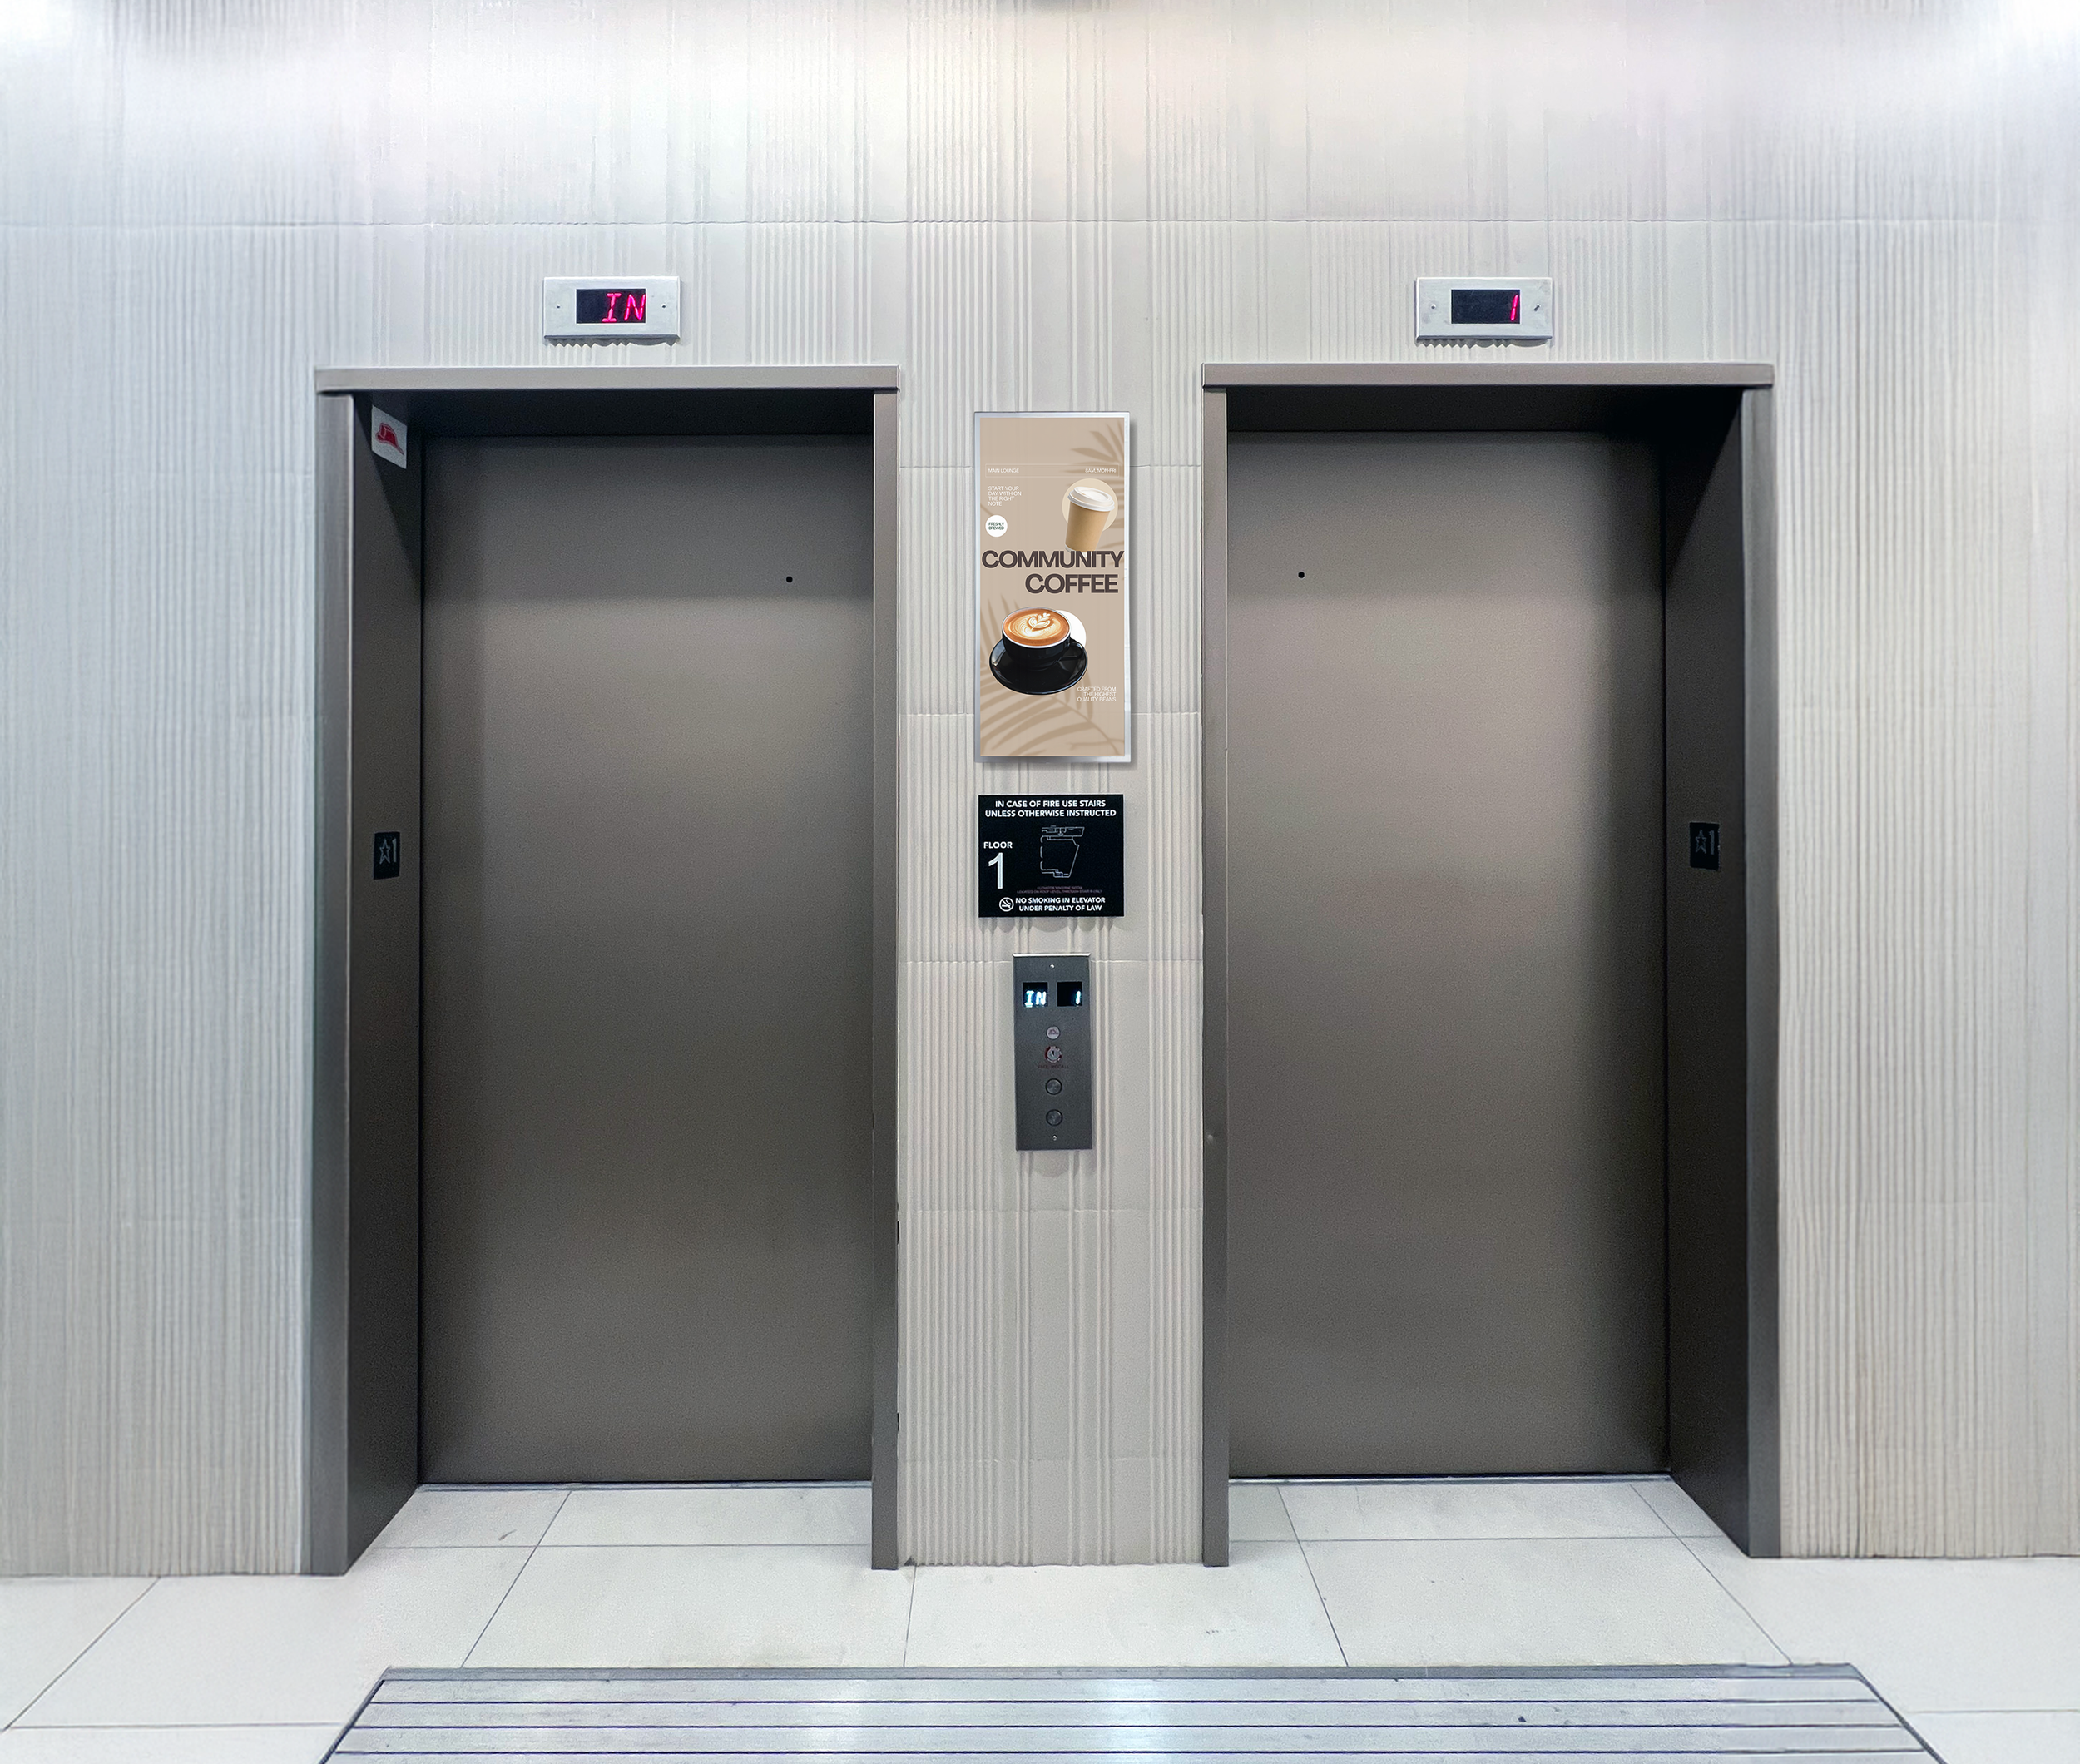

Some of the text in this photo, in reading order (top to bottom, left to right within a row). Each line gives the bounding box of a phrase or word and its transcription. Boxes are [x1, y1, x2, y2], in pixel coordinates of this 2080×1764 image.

[602, 292, 646, 322] IN
[1510, 295, 1518, 320] 1
[982, 550, 1124, 568] COMMUNITY
[1025, 573, 1118, 594] COFFEE
[392, 838, 396, 862] 1
[988, 852, 1003, 889] 1
[1024, 990, 1047, 1008] IN
[1075, 990, 1081, 1005] 1
